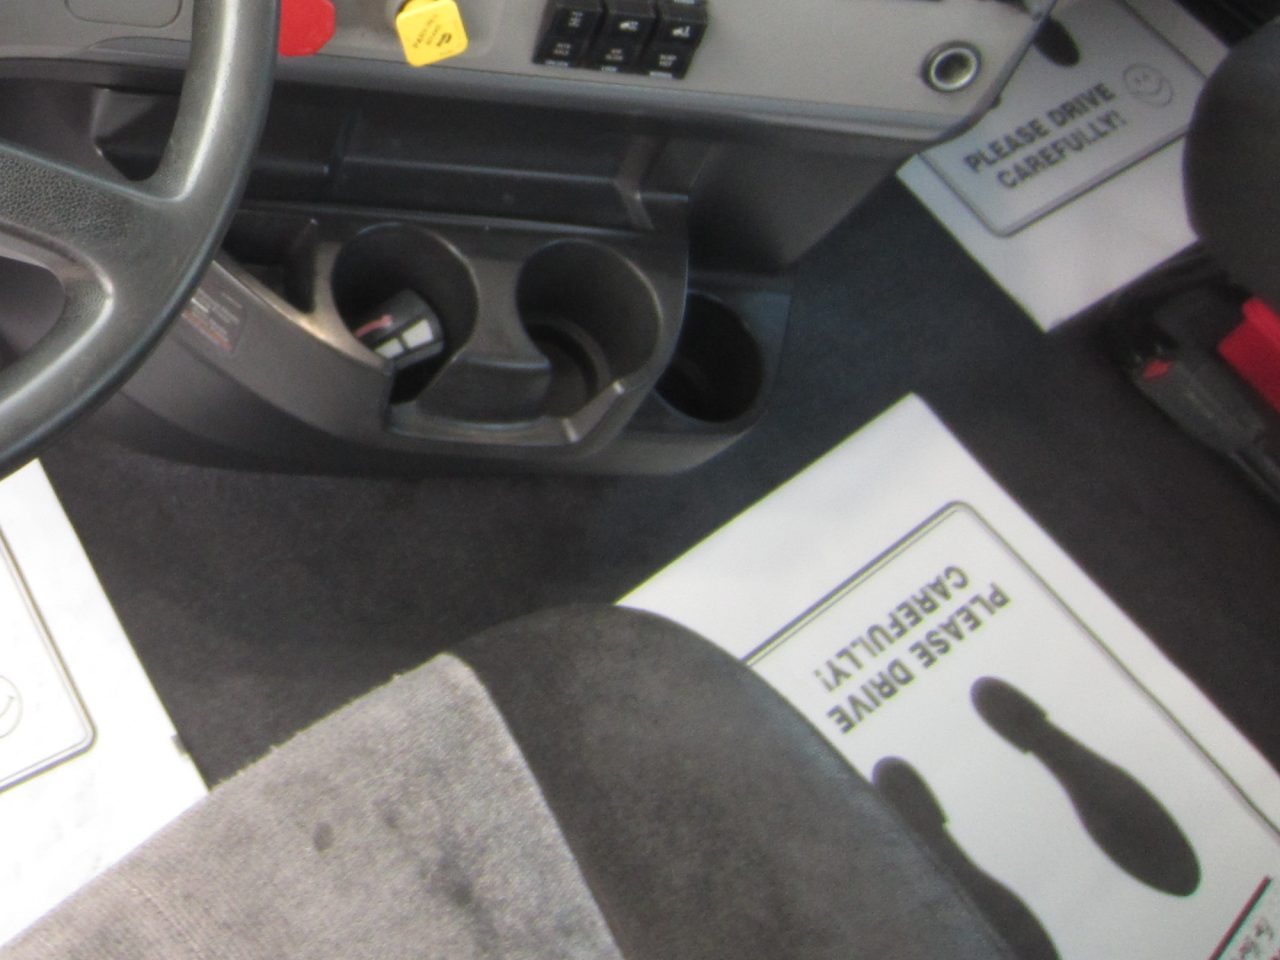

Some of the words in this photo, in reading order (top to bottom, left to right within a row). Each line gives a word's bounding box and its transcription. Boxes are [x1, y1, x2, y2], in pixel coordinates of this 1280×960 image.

[962, 117, 1050, 174] PLEASE
[1046, 82, 1116, 128] DRIVE
[995, 110, 1127, 189] CAREFULLY!
[813, 565, 971, 693] CAREFULLY!
[908, 583, 1012, 670] PLEASE
[825, 664, 915, 736] DRIVE
